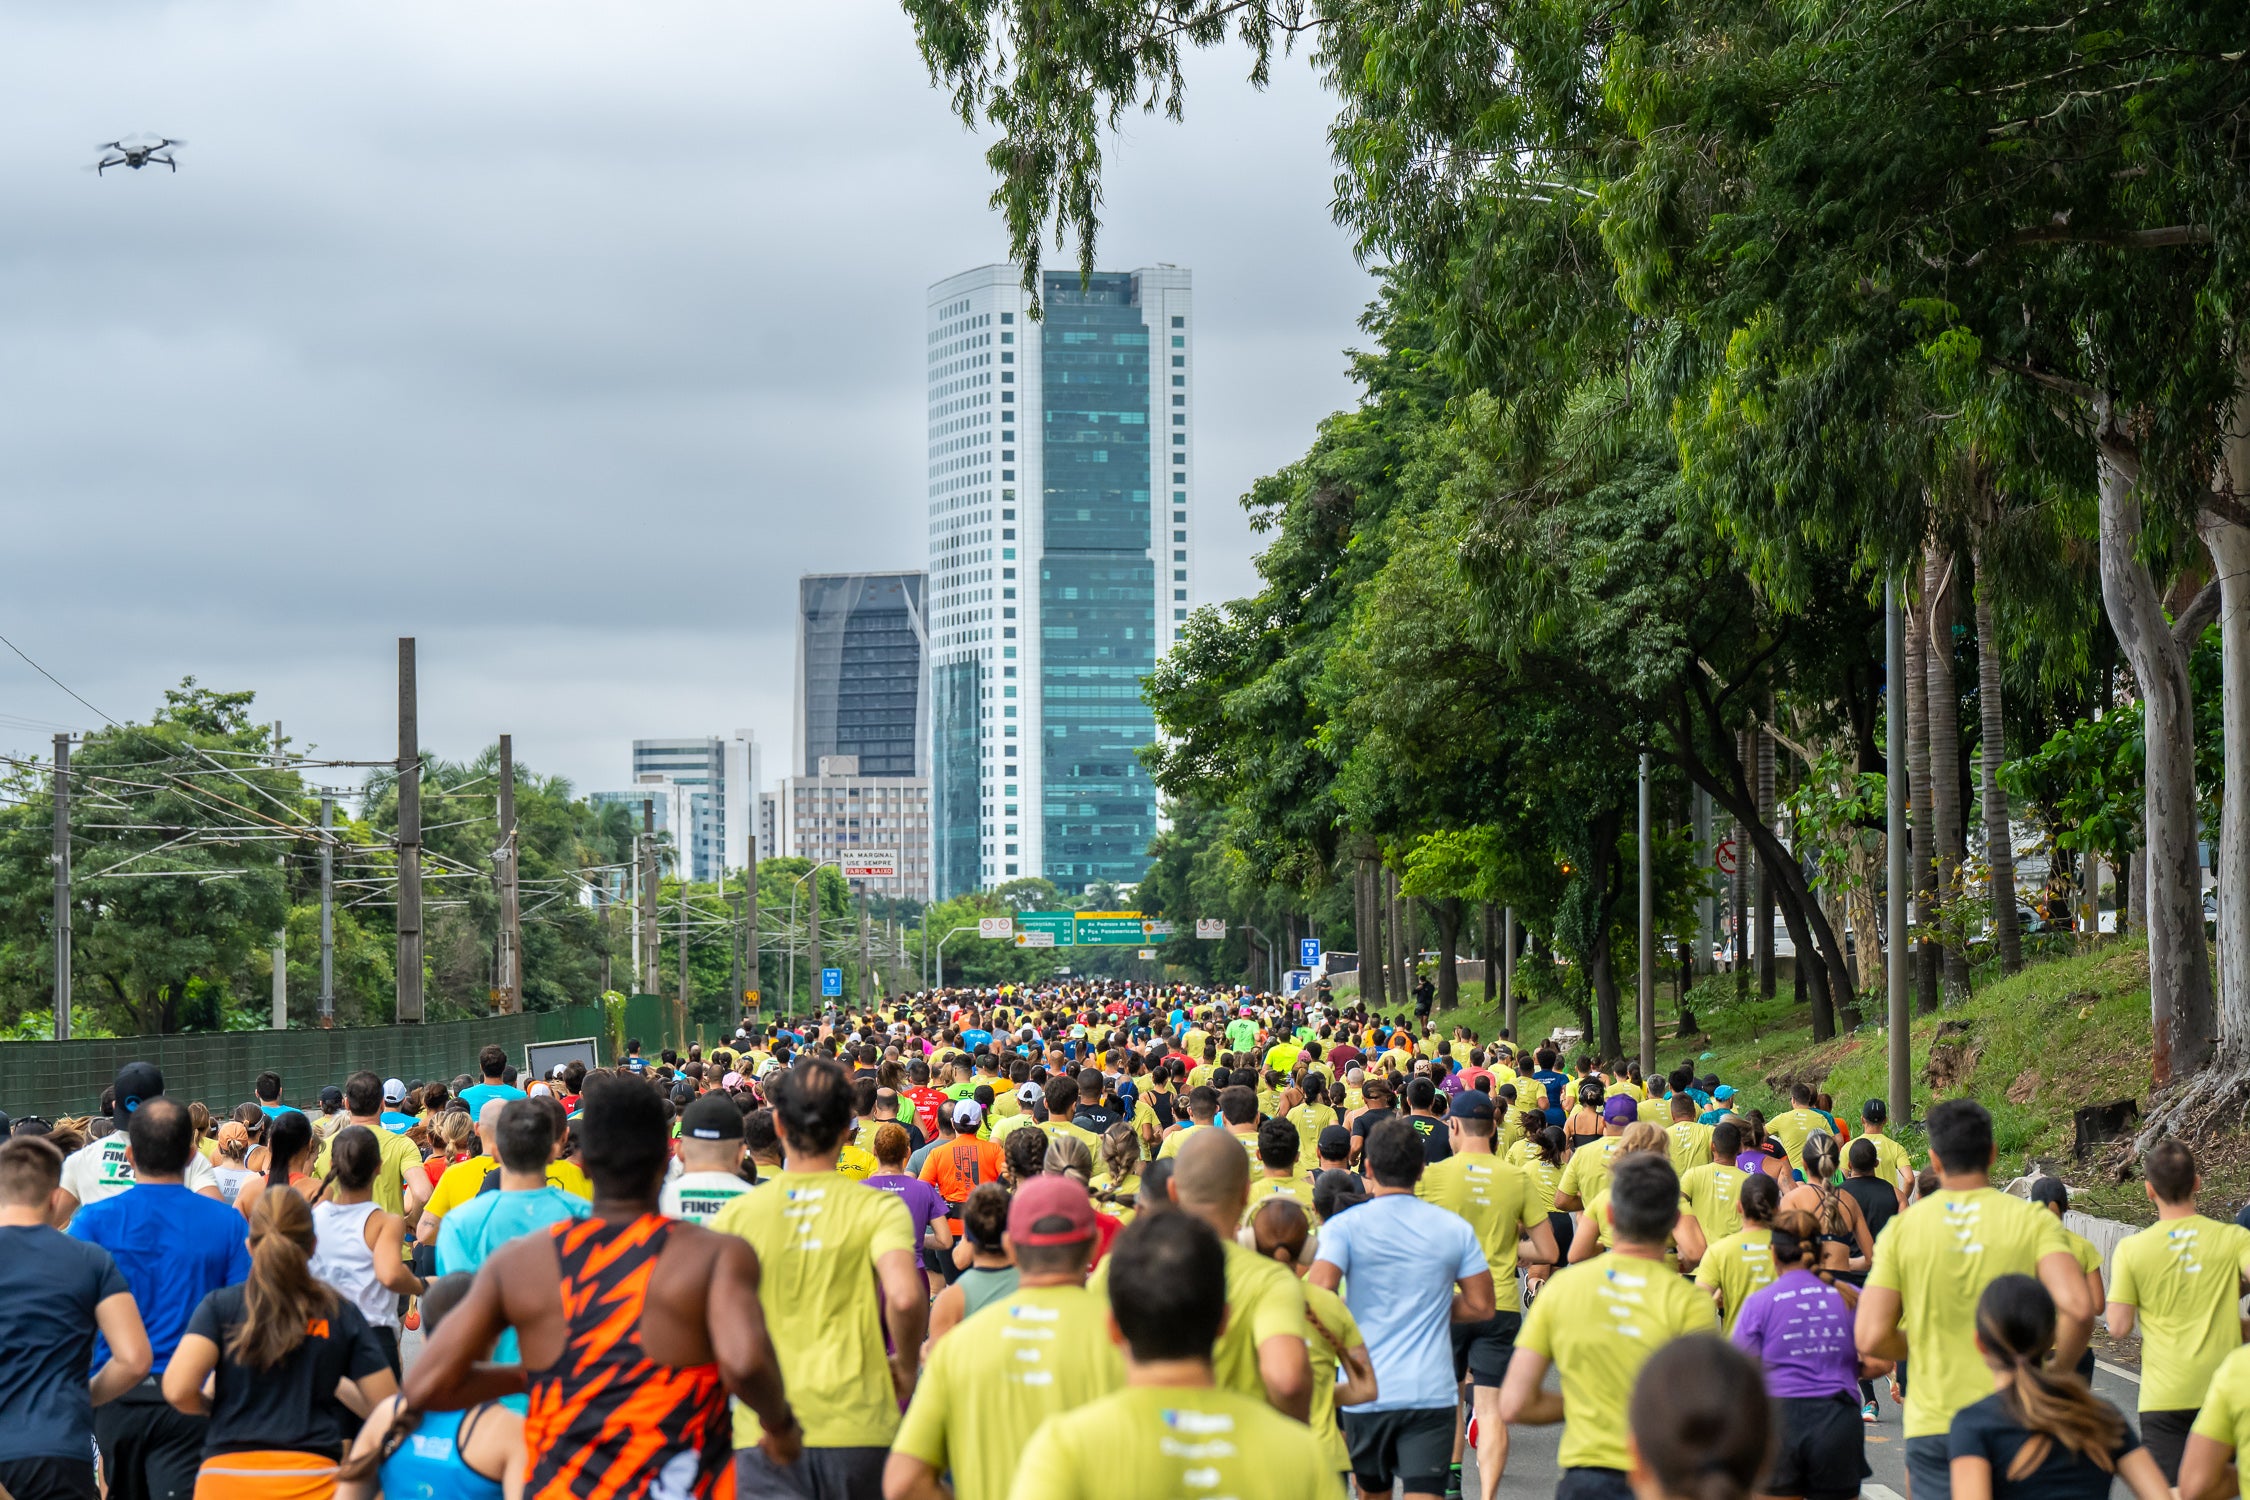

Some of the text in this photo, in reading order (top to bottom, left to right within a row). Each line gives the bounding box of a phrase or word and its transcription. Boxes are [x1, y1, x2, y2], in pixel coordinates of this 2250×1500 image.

[1307, 948, 1314, 956] 9
[829, 978, 836, 986] 9
[746, 991, 758, 1001] 90
[1096, 1115, 1107, 1123] DO
[681, 1201, 726, 1214] FINIS
